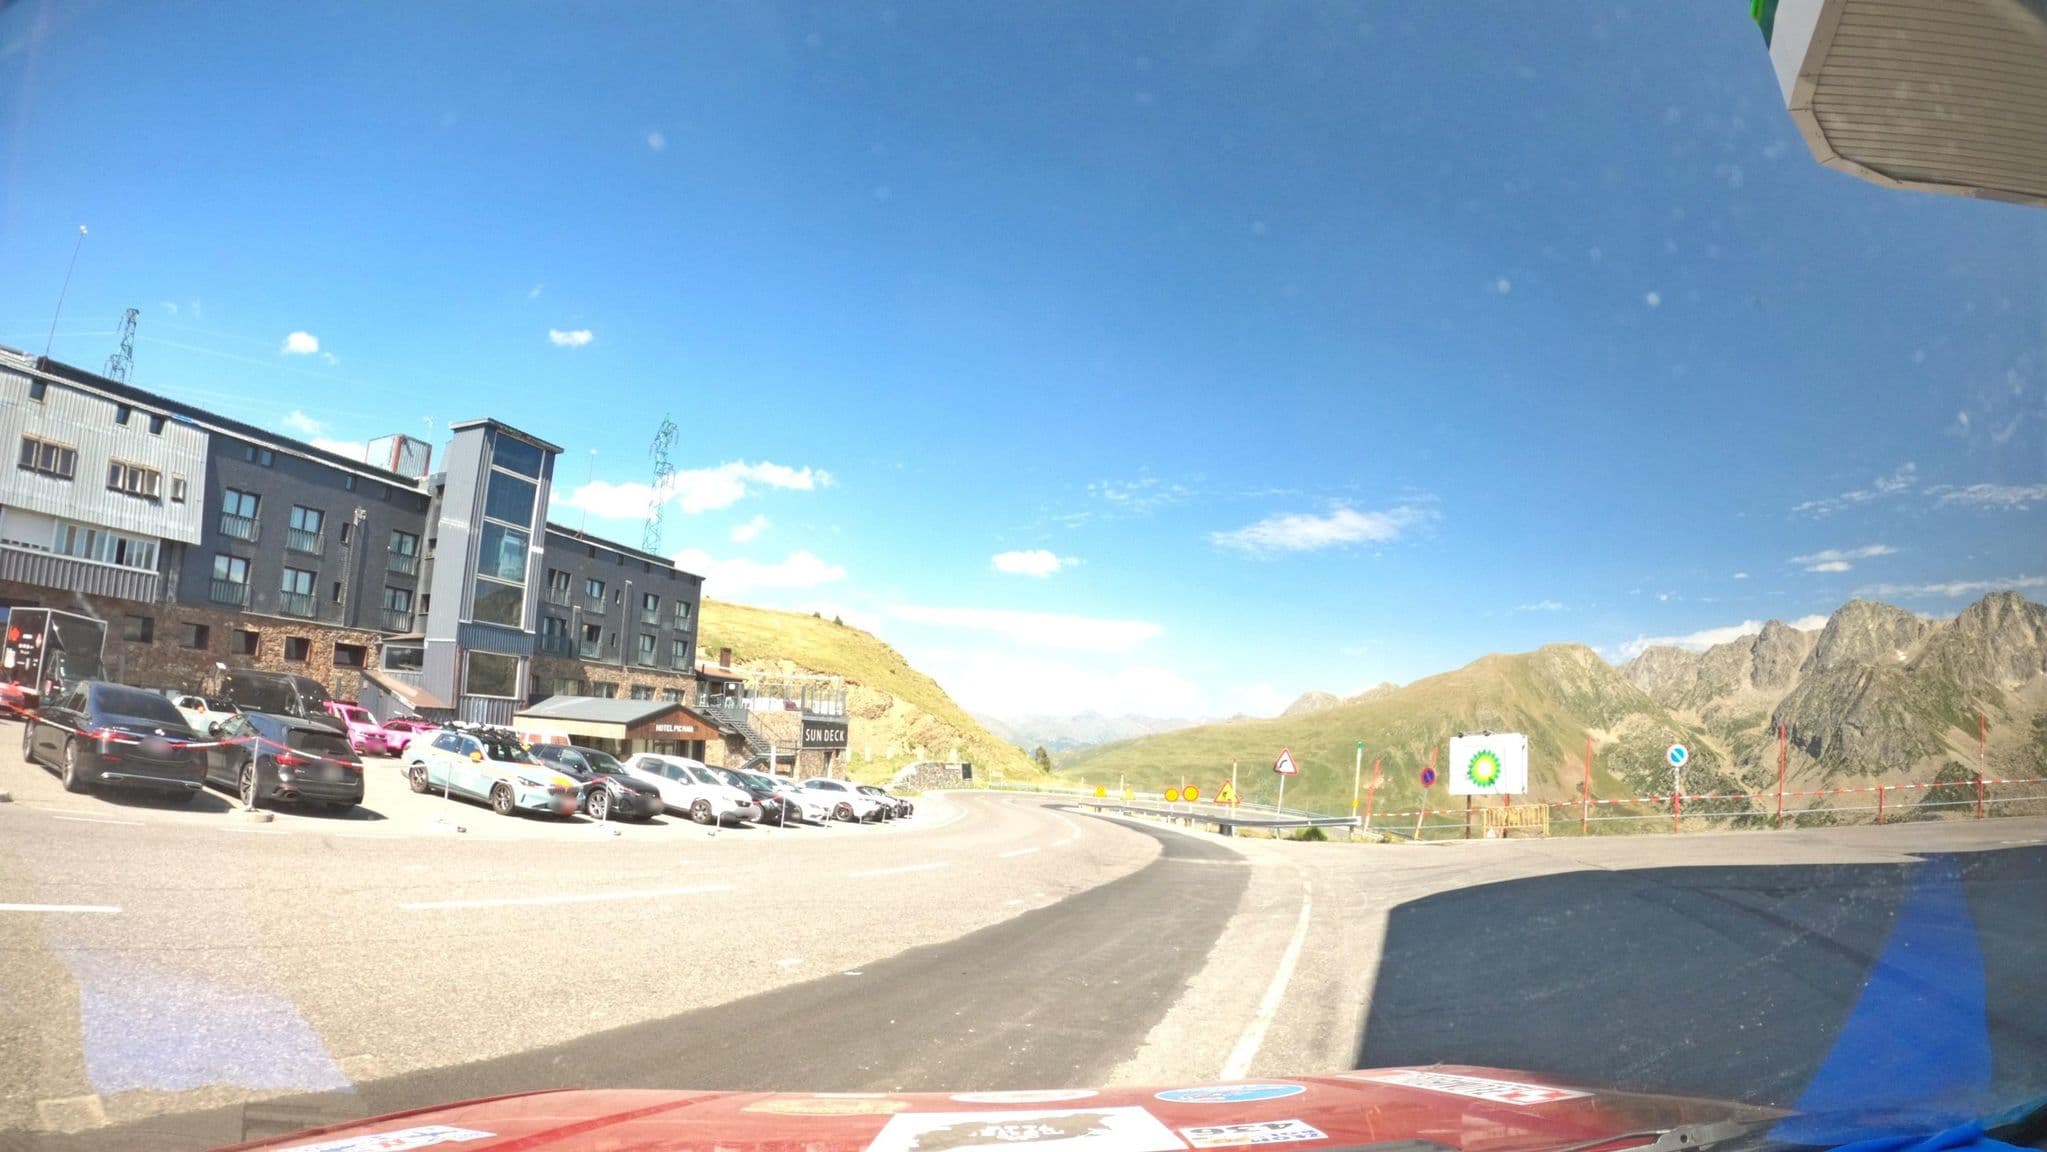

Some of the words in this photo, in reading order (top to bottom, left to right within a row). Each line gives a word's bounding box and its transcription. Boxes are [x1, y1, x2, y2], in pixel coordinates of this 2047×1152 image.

[656, 724, 672, 732] HOTEL
[806, 728, 822, 742] SUN
[824, 729, 844, 742] DECK
